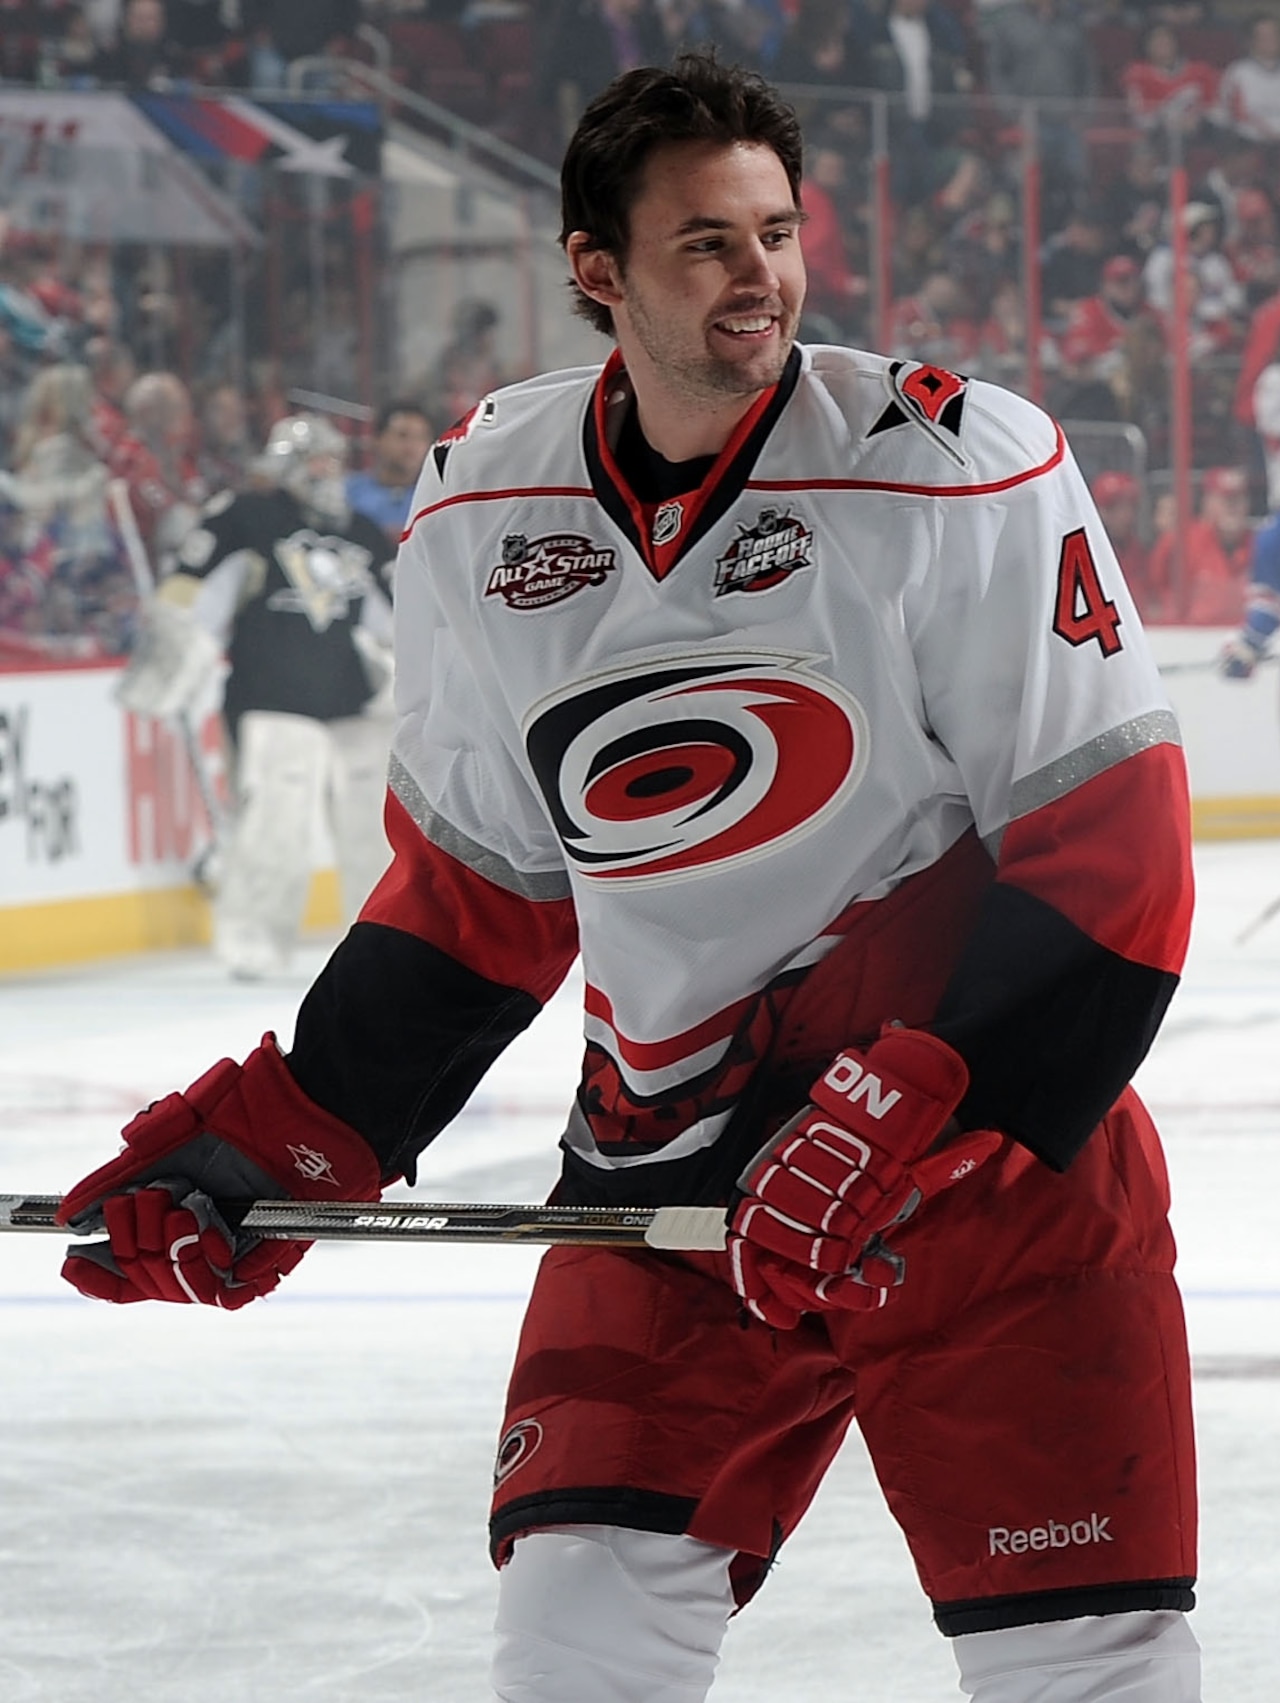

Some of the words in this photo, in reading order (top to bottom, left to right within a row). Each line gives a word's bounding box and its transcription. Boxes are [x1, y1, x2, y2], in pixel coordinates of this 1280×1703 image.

[738, 525, 800, 561] ROOKIE
[489, 567, 524, 590] ALL
[551, 552, 612, 576] STAR
[525, 577, 566, 592] GAME
[1052, 526, 1123, 659] 4
[824, 1052, 903, 1120] ON
[988, 1512, 1114, 1556] Reebok
